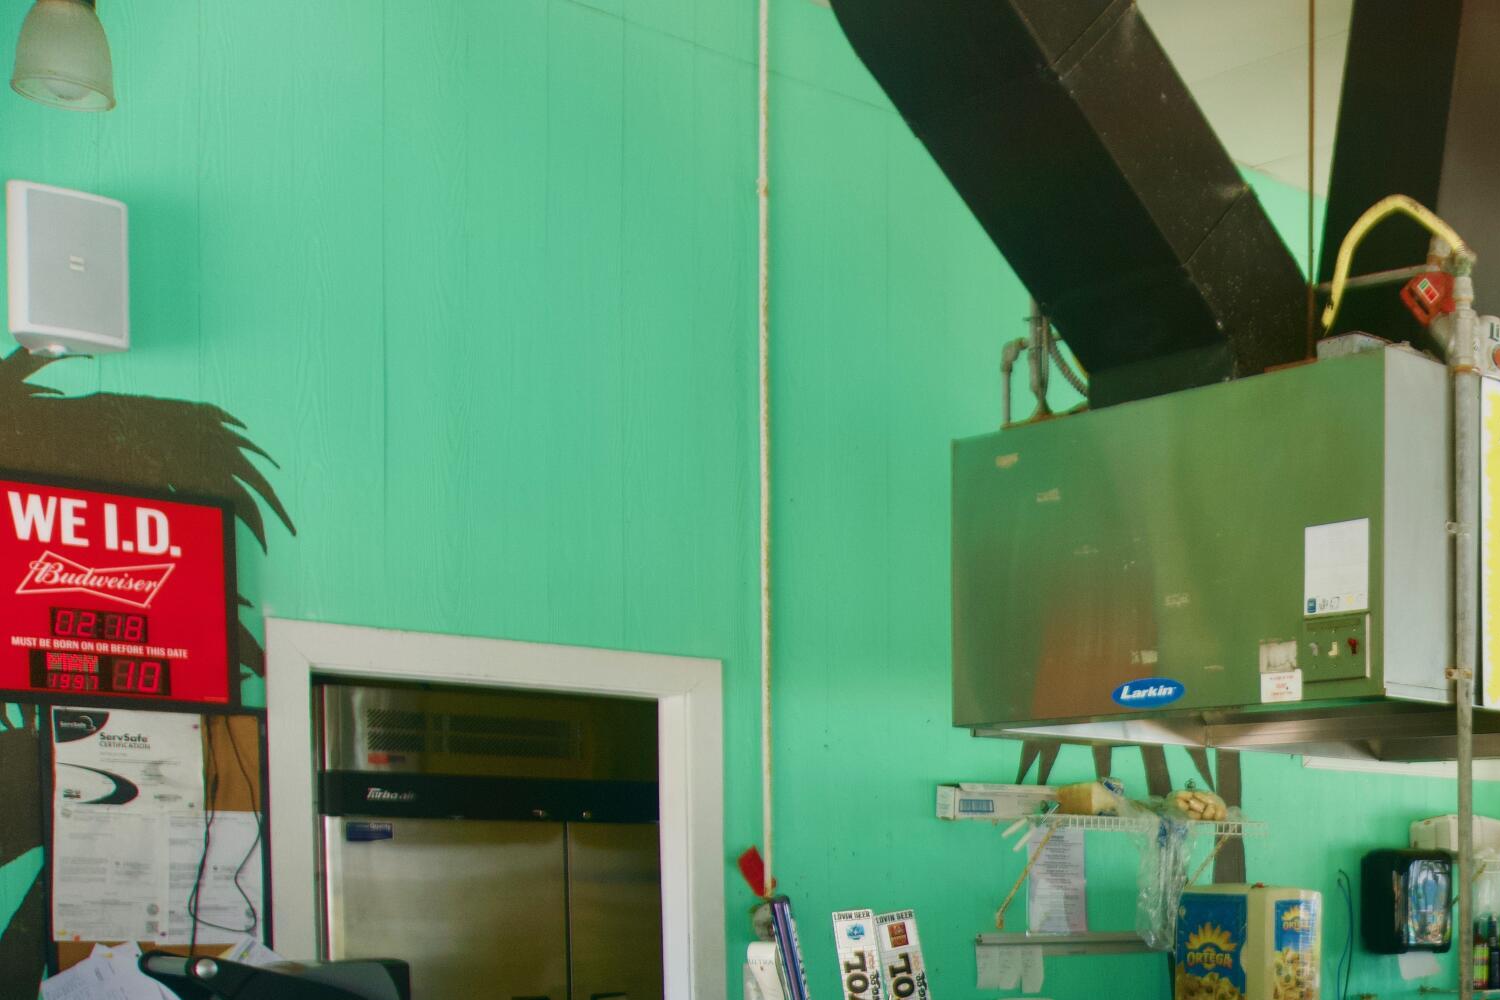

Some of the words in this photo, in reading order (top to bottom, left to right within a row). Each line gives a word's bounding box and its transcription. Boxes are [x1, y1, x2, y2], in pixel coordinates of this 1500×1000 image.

[8, 491, 89, 547] WE
[104, 502, 182, 558] I.D.
[29, 559, 159, 592] Budweiser
[11, 636, 37, 647] MUST
[39, 638, 52, 648] BE
[53, 639, 79, 650] BORN
[81, 640, 95, 651] ON
[96, 642, 109, 652] OR
[110, 643, 144, 656] BEFORE
[146, 645, 166, 657] THIS
[167, 647, 188, 659] DATE
[125, 661, 162, 693] 10
[1120, 684, 1174, 700] Larkin
[100, 732, 148, 743] ServSafe
[366, 787, 398, 800] Turbo
[834, 911, 853, 921] LOVIN
[853, 911, 870, 919] BEER
[876, 915, 895, 924] LOVIN
[895, 911, 913, 922] BEER
[1187, 952, 1232, 970] ORTEGA
